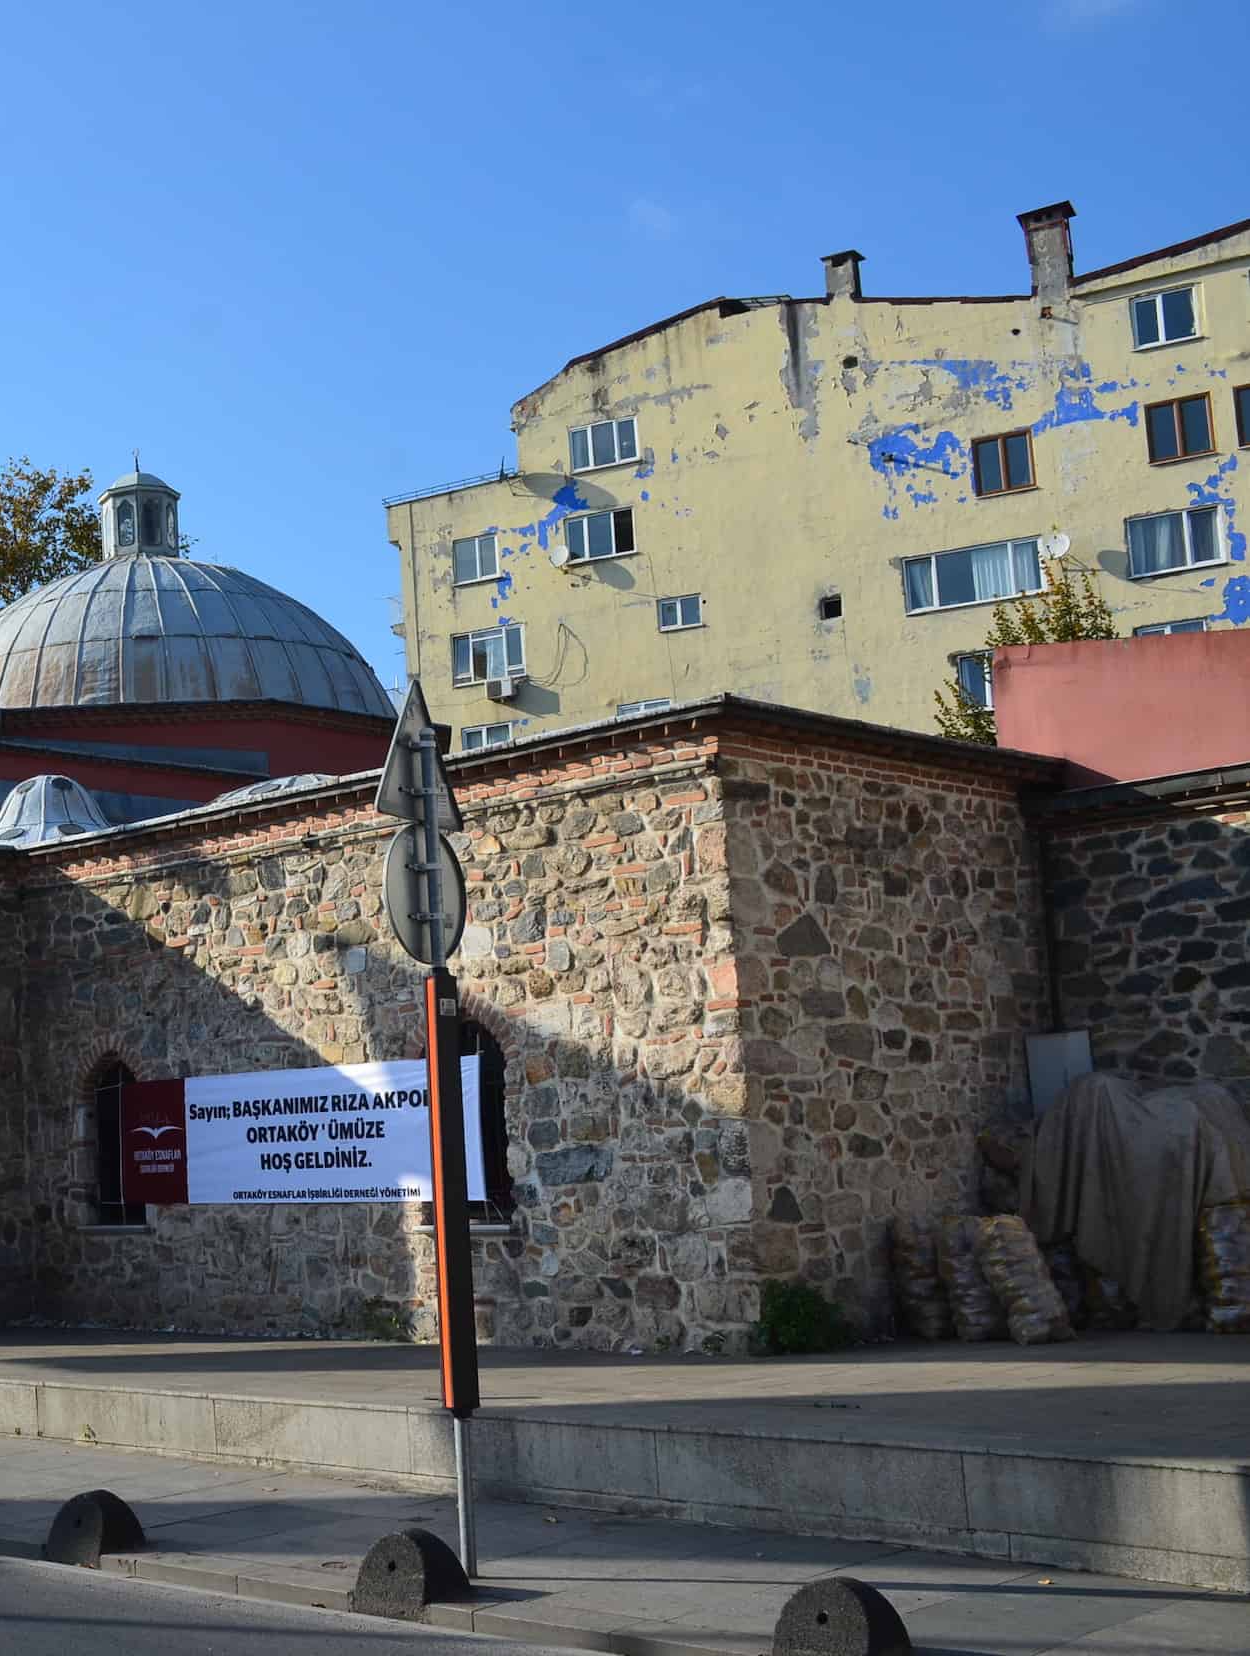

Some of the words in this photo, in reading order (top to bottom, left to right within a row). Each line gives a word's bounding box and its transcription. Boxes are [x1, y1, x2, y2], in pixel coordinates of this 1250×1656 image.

[189, 1103, 231, 1123] Sayın;
[233, 1095, 329, 1120] BAŞKANIMIZ
[331, 1092, 370, 1111] RIZA
[246, 1121, 319, 1143] ORTAKÖY
[328, 1117, 385, 1140] ÜMÜZE
[260, 1151, 292, 1174] HOŞ
[295, 1145, 372, 1170] GELDİNİZ.
[232, 1188, 267, 1199] ORTAKÖY
[269, 1190, 307, 1199] ESNAFLAR
[307, 1187, 343, 1200] İŞBİRLİĞİ
[343, 1187, 378, 1199] DERNEĞİ
[379, 1186, 421, 1198] YÖNETİMİ
